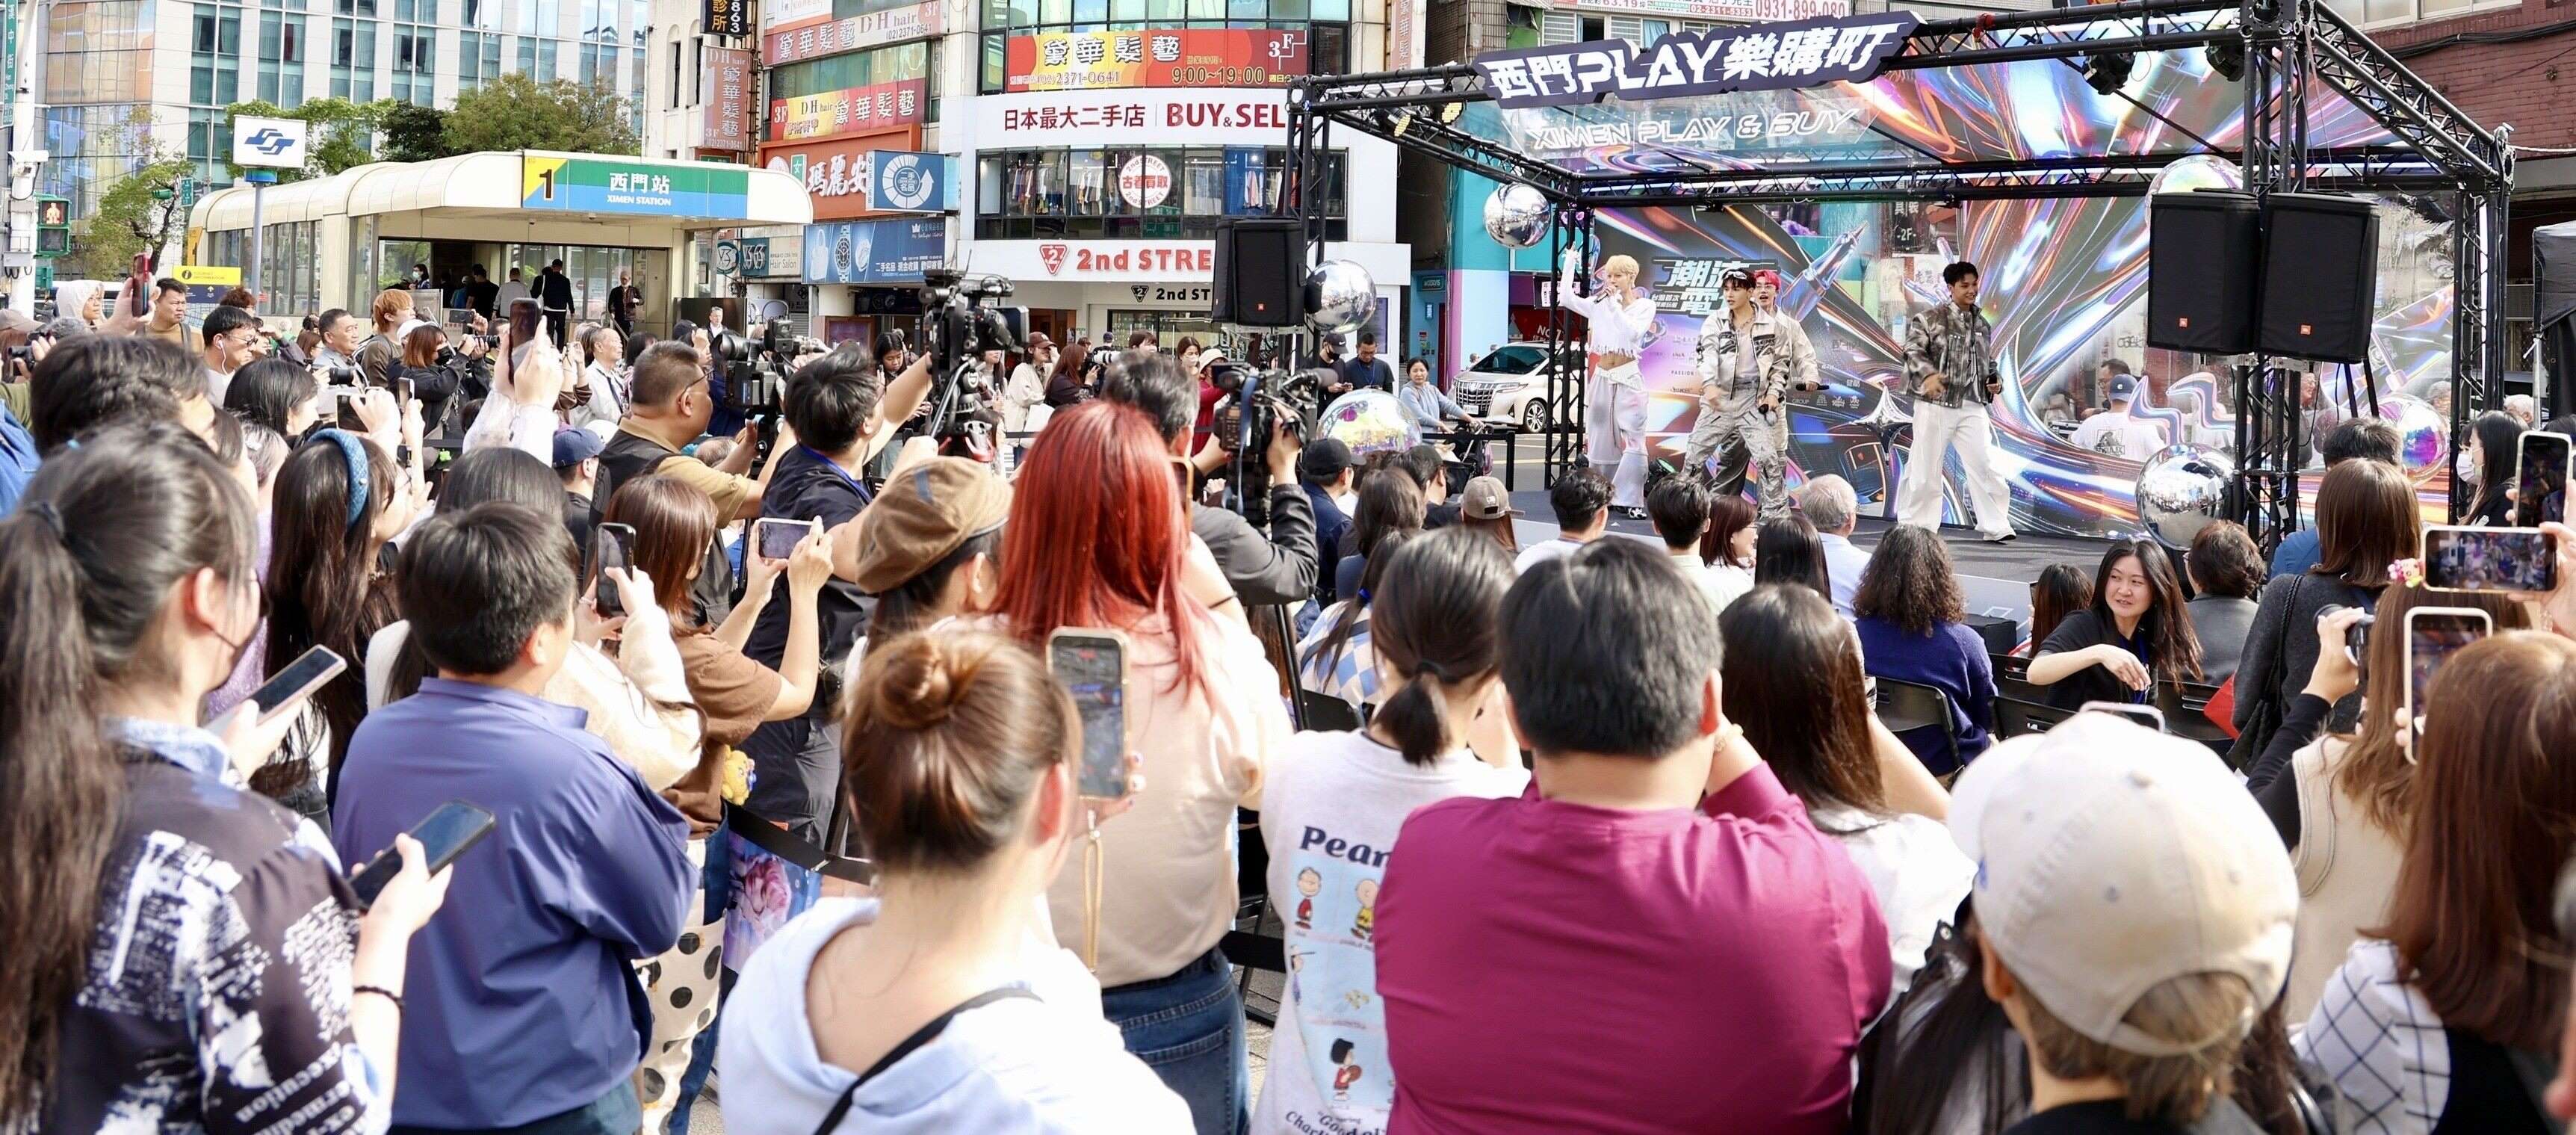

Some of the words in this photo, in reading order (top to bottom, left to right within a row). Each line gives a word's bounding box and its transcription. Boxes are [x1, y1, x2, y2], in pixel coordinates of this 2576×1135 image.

[731, 0, 740, 32] 863
[894, 11, 917, 26] hair
[1171, 66, 1266, 84] 9:00~19:00
[1269, 74, 1297, 83] 週日公
[1005, 103, 1145, 131] 日本最大二手店
[1526, 123, 1632, 149] XIMEN
[1638, 116, 1733, 143] PLAY
[1767, 108, 1860, 137] BUY
[539, 169, 553, 200] 1
[609, 172, 670, 194] 西門站
[607, 194, 634, 204] XIMEN
[636, 196, 671, 206] STATION
[1077, 249, 1130, 271] 2nd
[1157, 288, 1186, 300] 2nd
